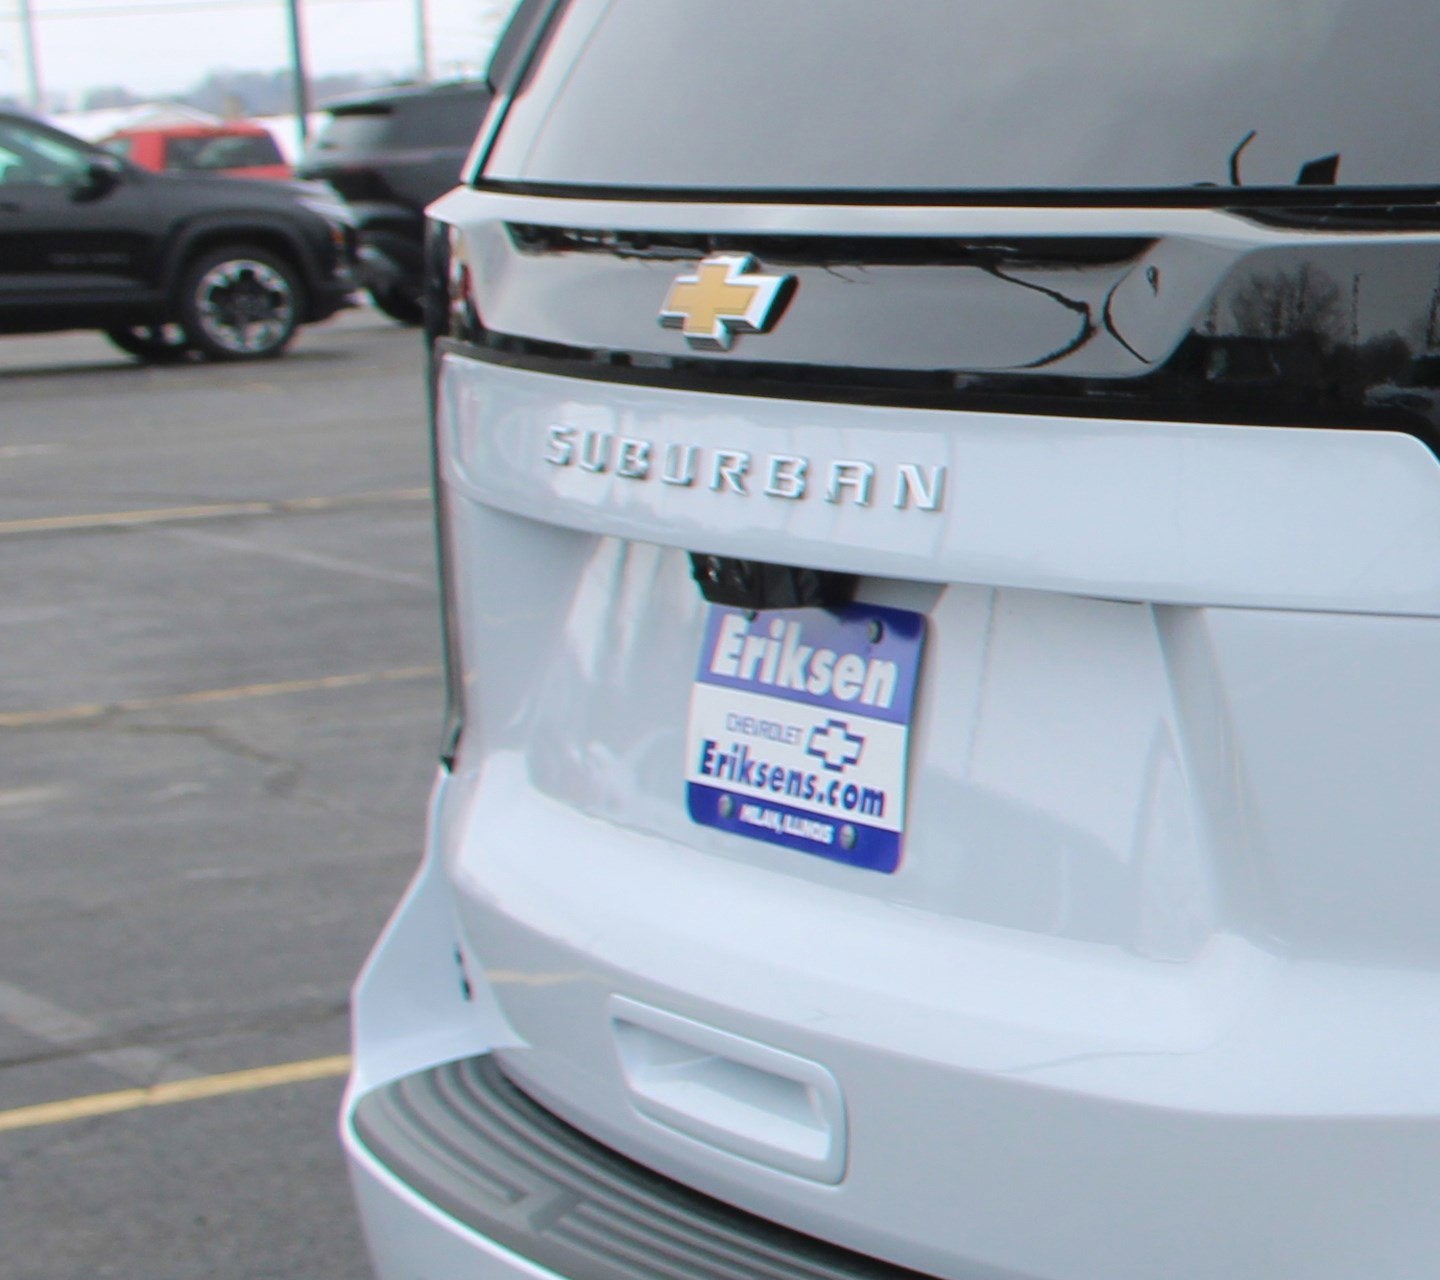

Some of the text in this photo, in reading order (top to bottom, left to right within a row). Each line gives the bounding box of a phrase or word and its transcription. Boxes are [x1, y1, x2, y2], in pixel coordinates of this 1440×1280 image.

[544, 424, 947, 511] SUBURBAN
[709, 613, 899, 708] Eriksen
[725, 711, 804, 746] CHEVROLET
[699, 738, 886, 818] Eriksens.com
